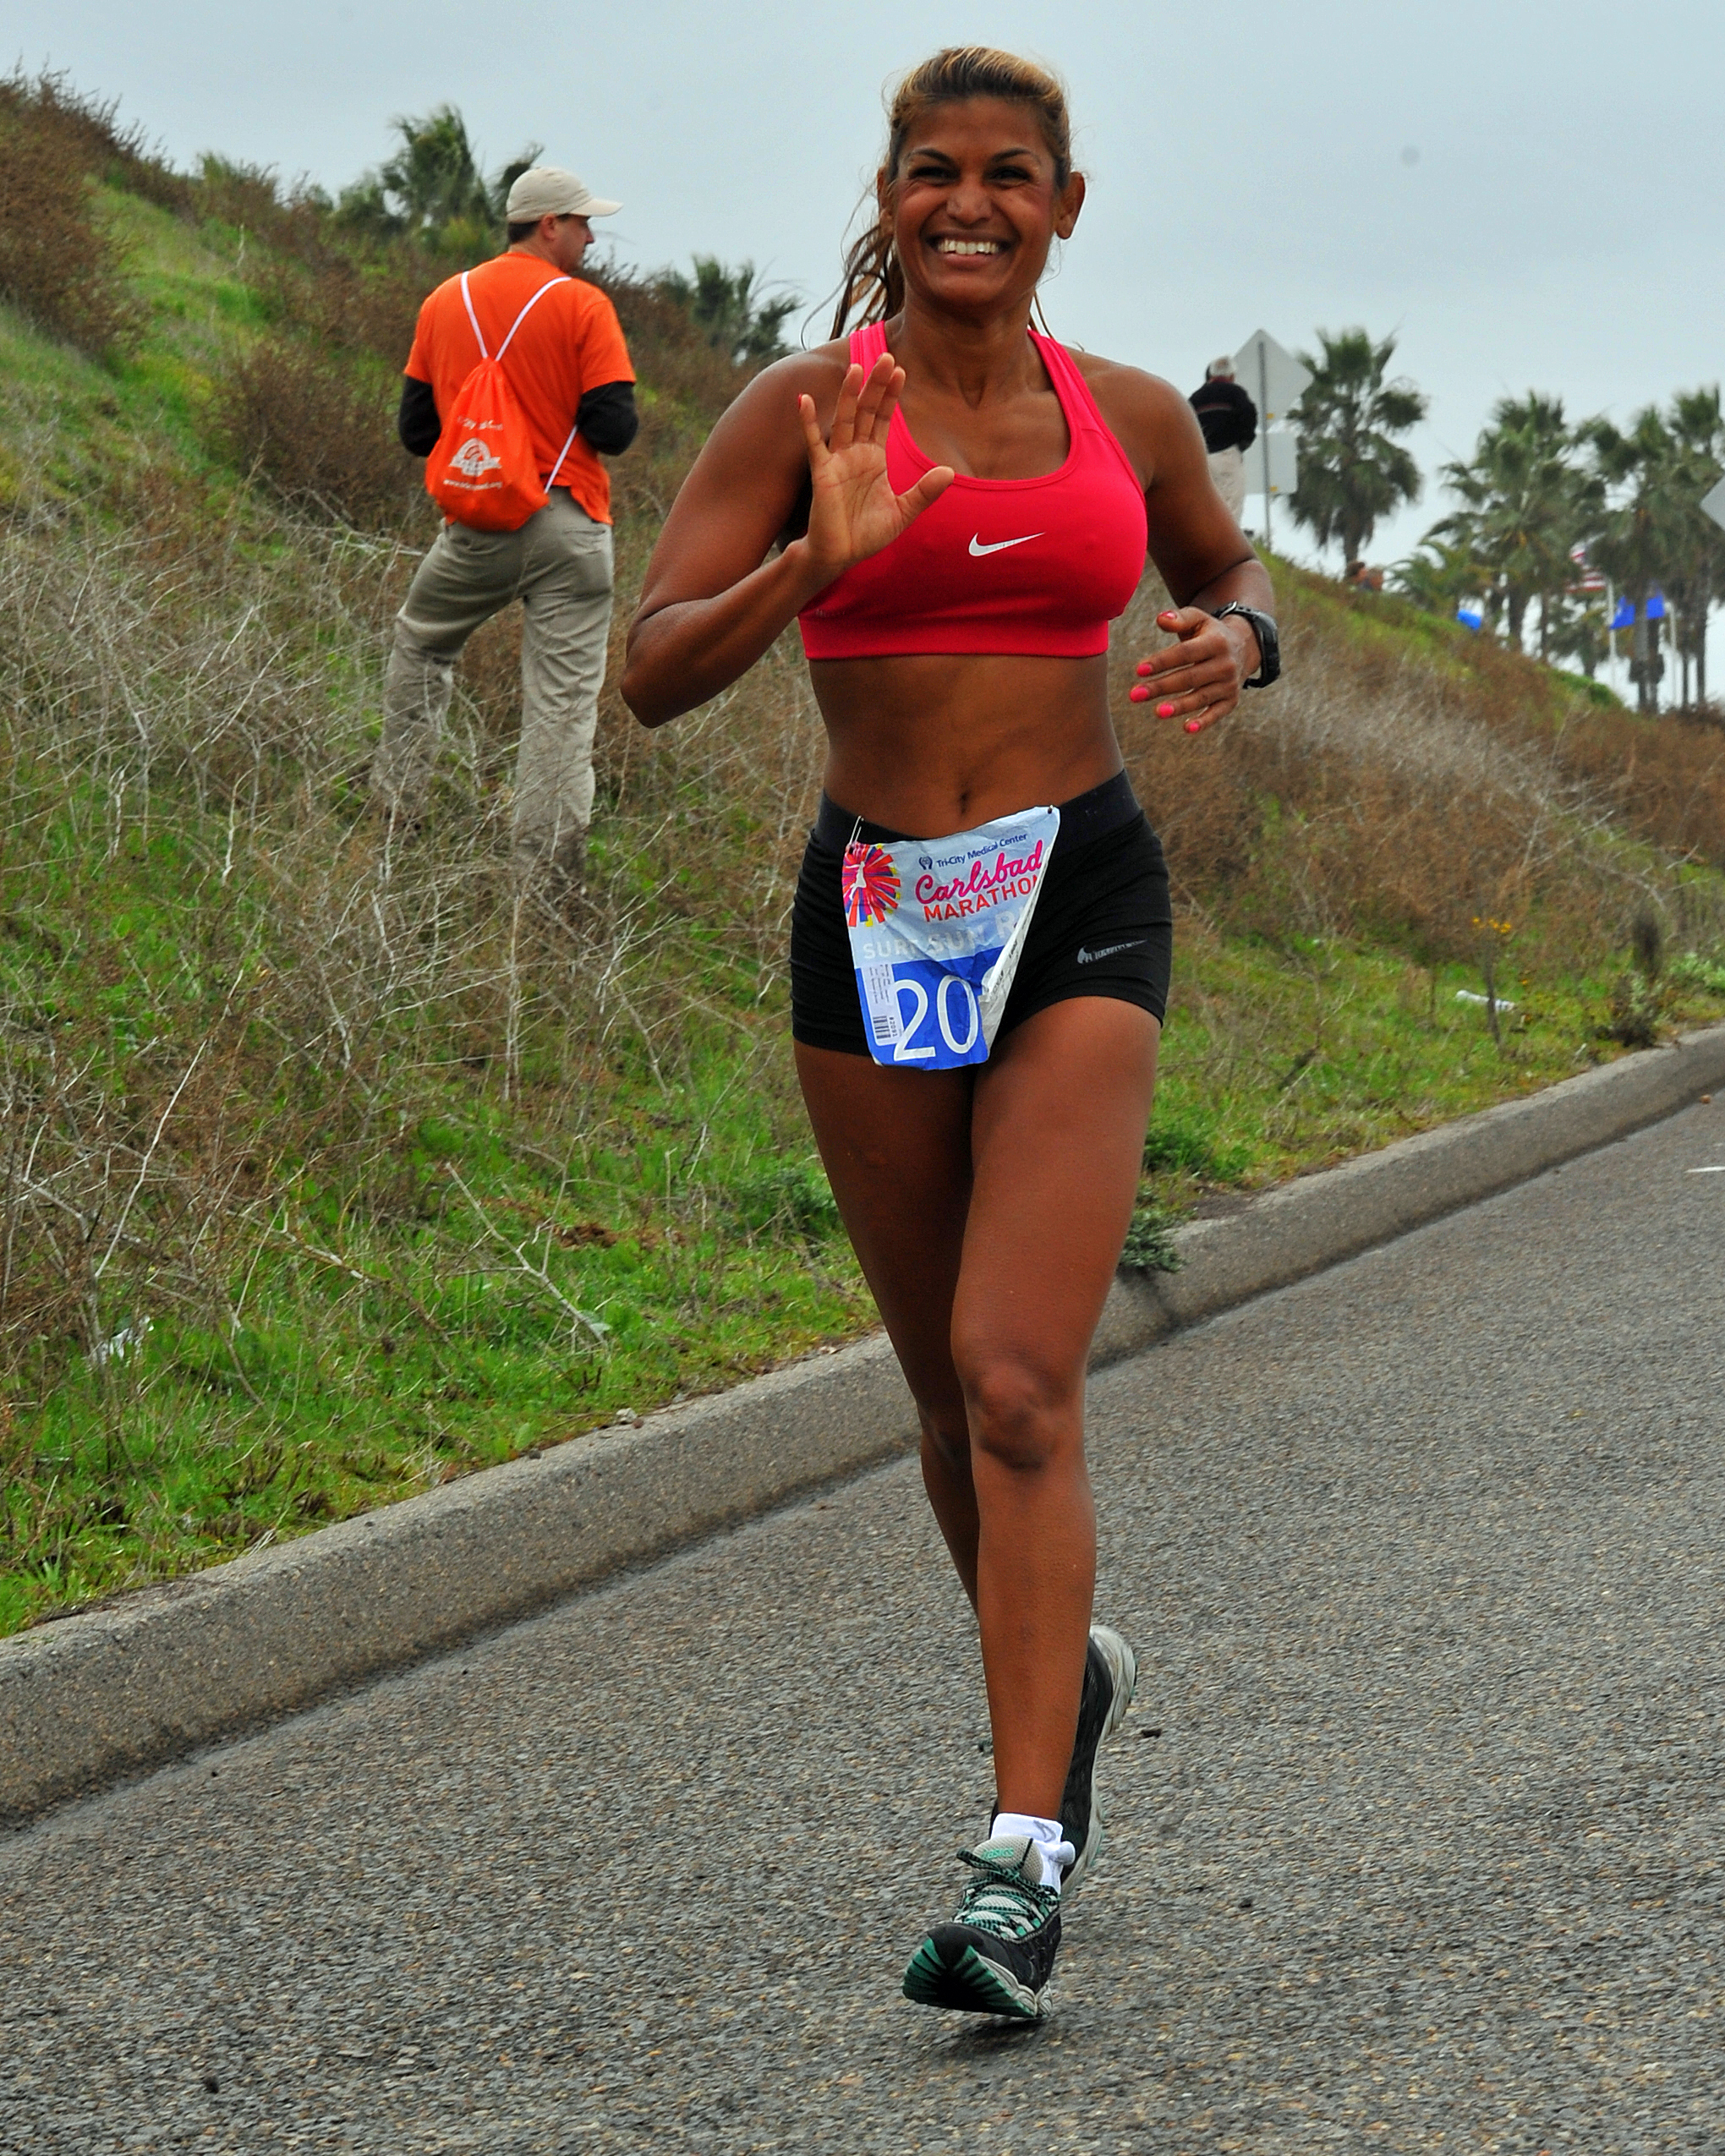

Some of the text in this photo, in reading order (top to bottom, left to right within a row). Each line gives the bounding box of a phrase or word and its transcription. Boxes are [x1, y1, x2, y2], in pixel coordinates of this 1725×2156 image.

[915, 840, 1043, 905] Carlsbad
[936, 834, 1028, 868] Tri-City Medical Center
